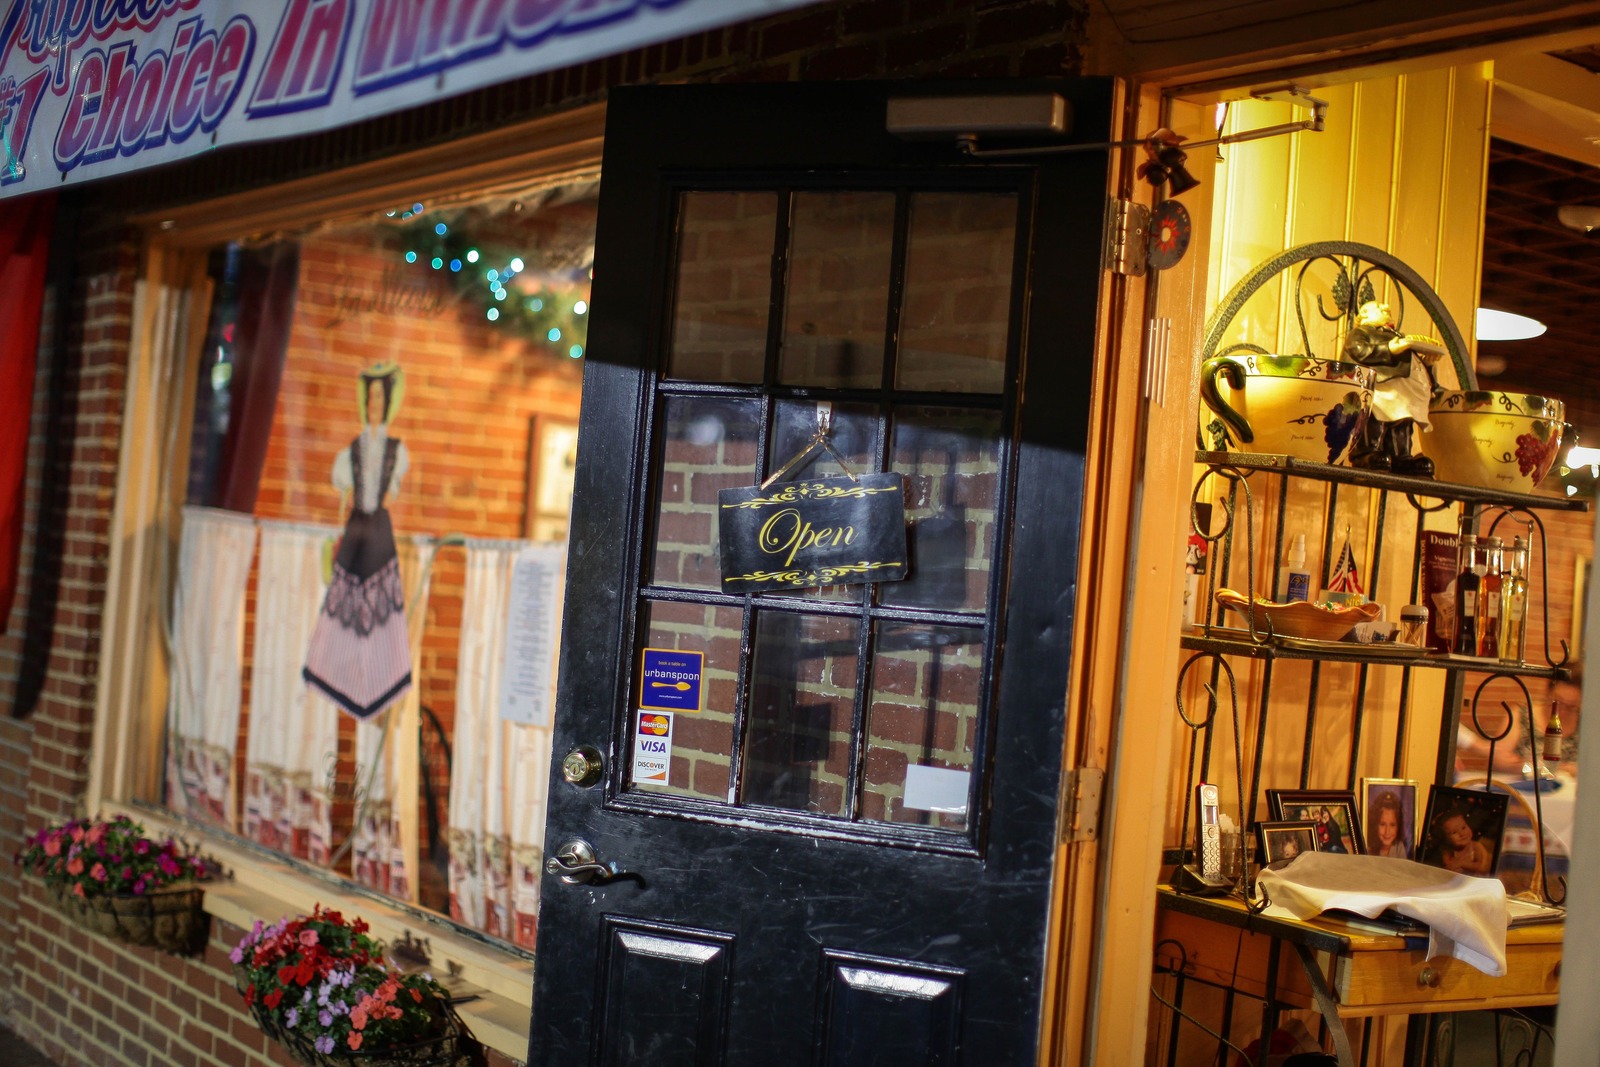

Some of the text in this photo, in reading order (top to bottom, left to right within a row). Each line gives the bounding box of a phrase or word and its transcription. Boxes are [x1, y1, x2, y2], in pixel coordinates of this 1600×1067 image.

[53, 13, 257, 172] Choice
[759, 508, 859, 567] Open
[644, 669, 700, 681] urbanspoon
[641, 720, 669, 730] MasterCard
[640, 740, 667, 753] VISA
[637, 760, 665, 770] DISCOVER
